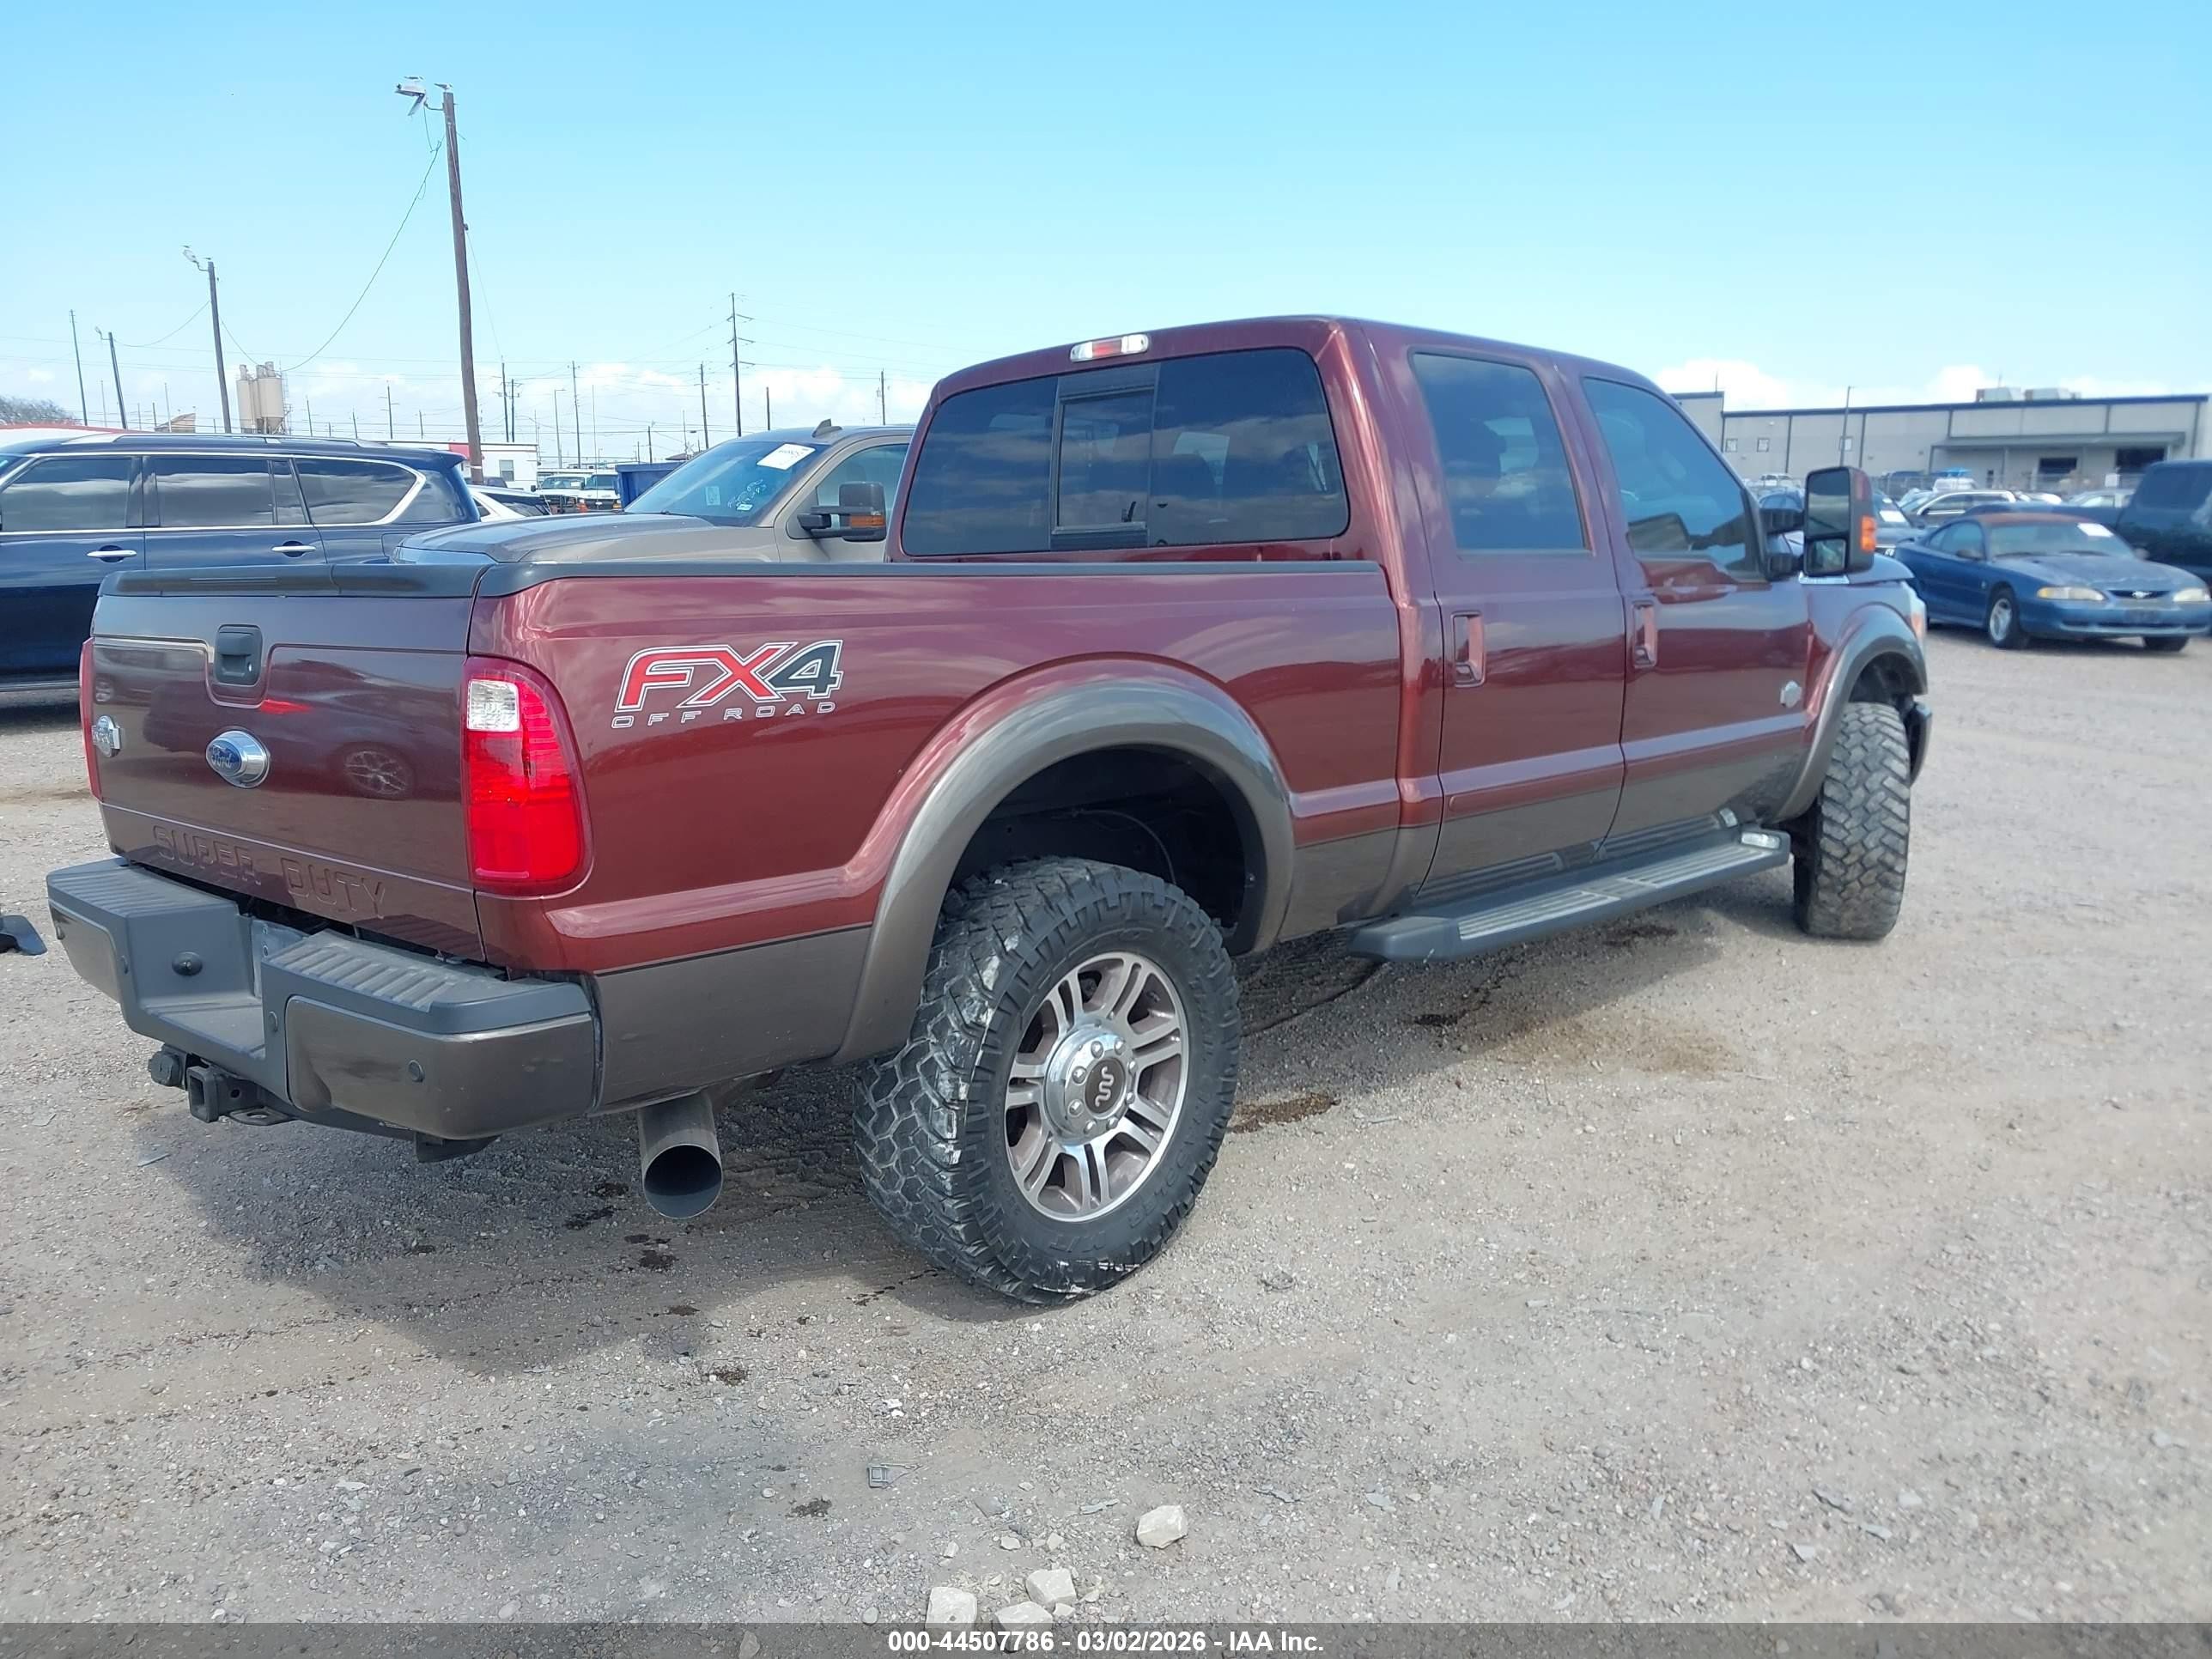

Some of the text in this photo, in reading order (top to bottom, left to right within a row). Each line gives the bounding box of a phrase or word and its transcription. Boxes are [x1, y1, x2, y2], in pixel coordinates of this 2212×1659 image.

[614, 640, 843, 713] FX4
[611, 702, 836, 729] OFF ROAD
[153, 824, 386, 920] SUPER DUTY
